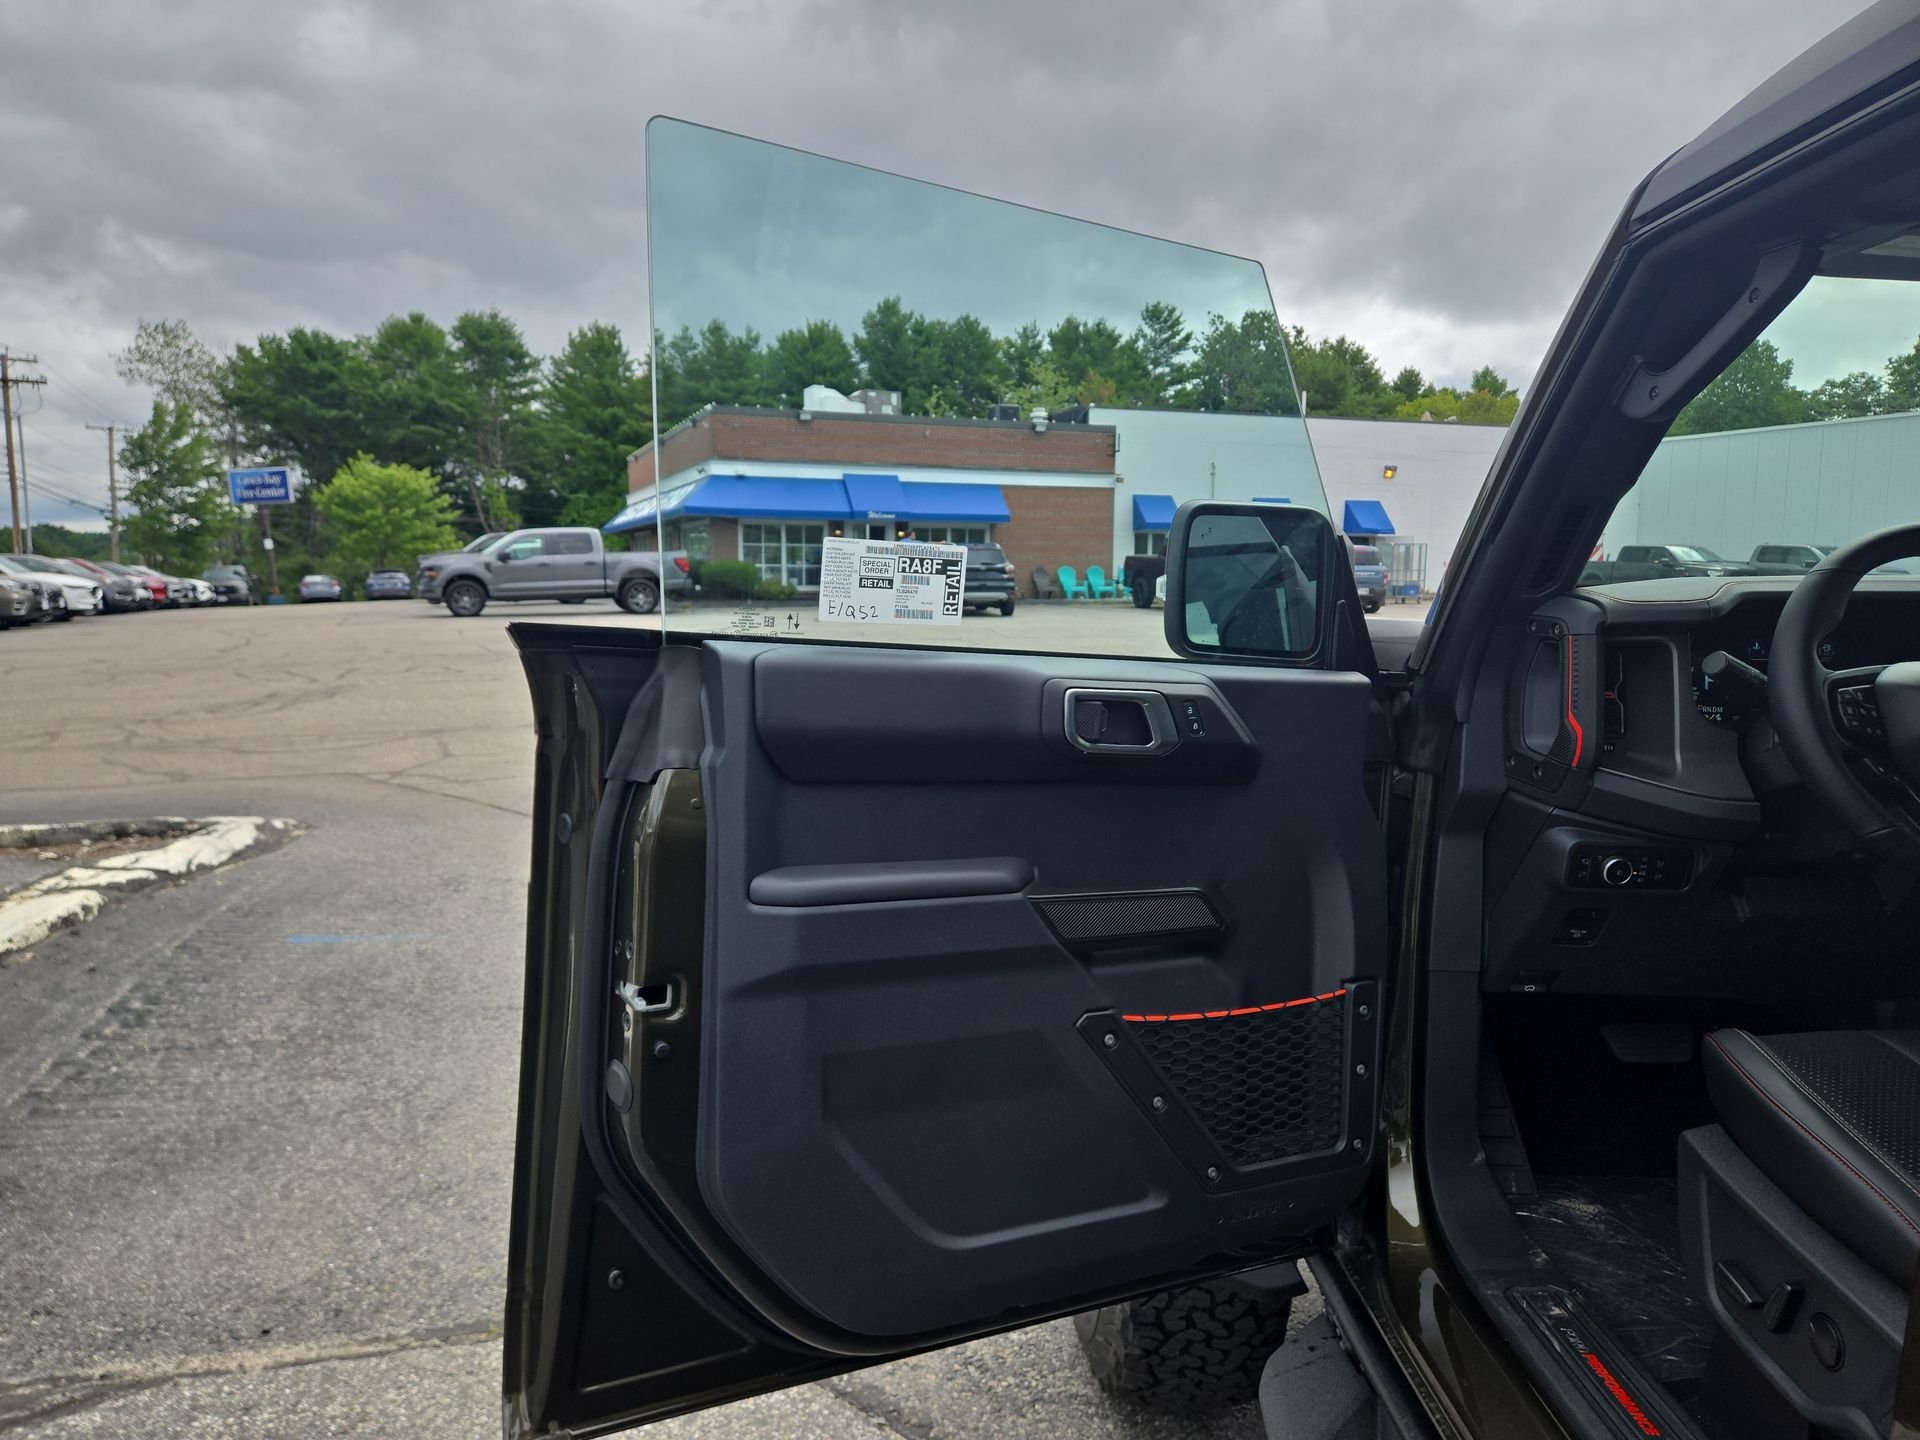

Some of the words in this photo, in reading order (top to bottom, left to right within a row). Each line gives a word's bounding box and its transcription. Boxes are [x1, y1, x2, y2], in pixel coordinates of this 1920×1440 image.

[862, 560, 892, 568] SPECIAL
[898, 557, 943, 574] RA8F
[861, 579, 891, 588] RETAIL
[943, 562, 961, 615] RETAIL
[1584, 1353, 1661, 1437] PERFORMANCE
